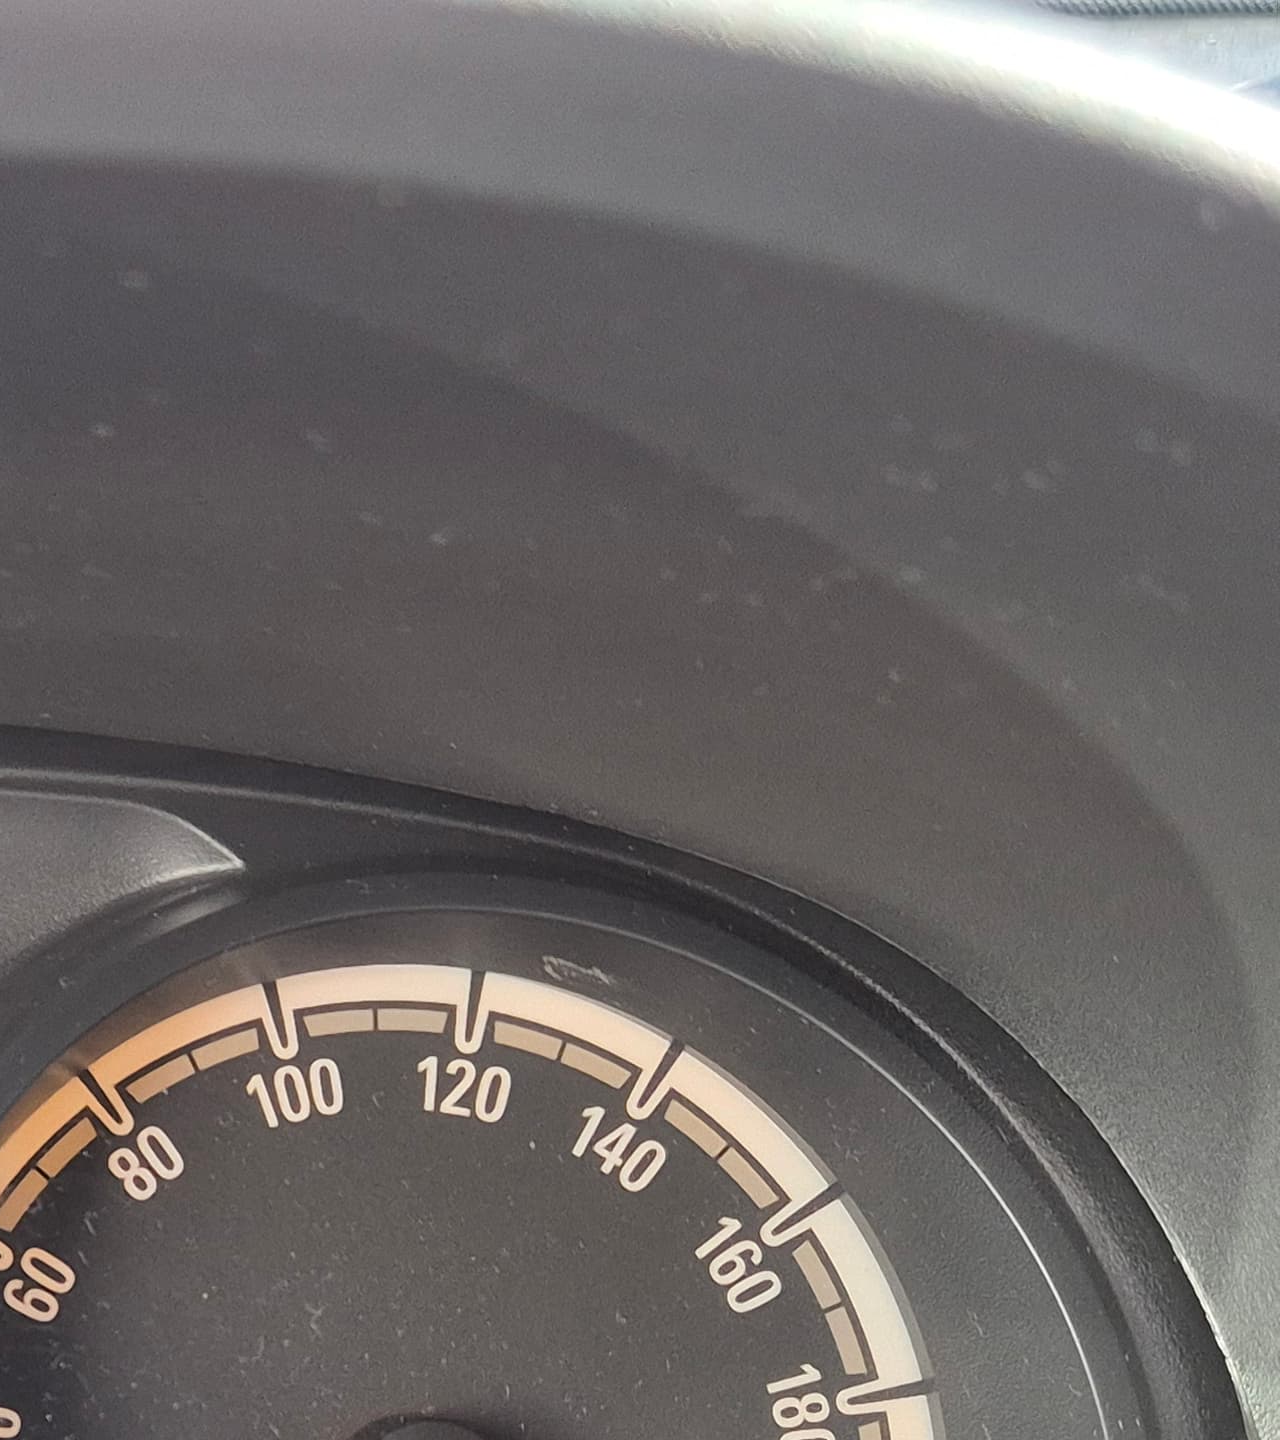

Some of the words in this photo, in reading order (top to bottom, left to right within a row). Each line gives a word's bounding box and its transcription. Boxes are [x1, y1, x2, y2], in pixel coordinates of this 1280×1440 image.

[246, 1058, 343, 1129] 100
[416, 1055, 511, 1123] 120
[107, 1125, 185, 1201] 80
[570, 1106, 666, 1192] 140
[3, 1247, 76, 1323] 60
[694, 1216, 782, 1313] 160
